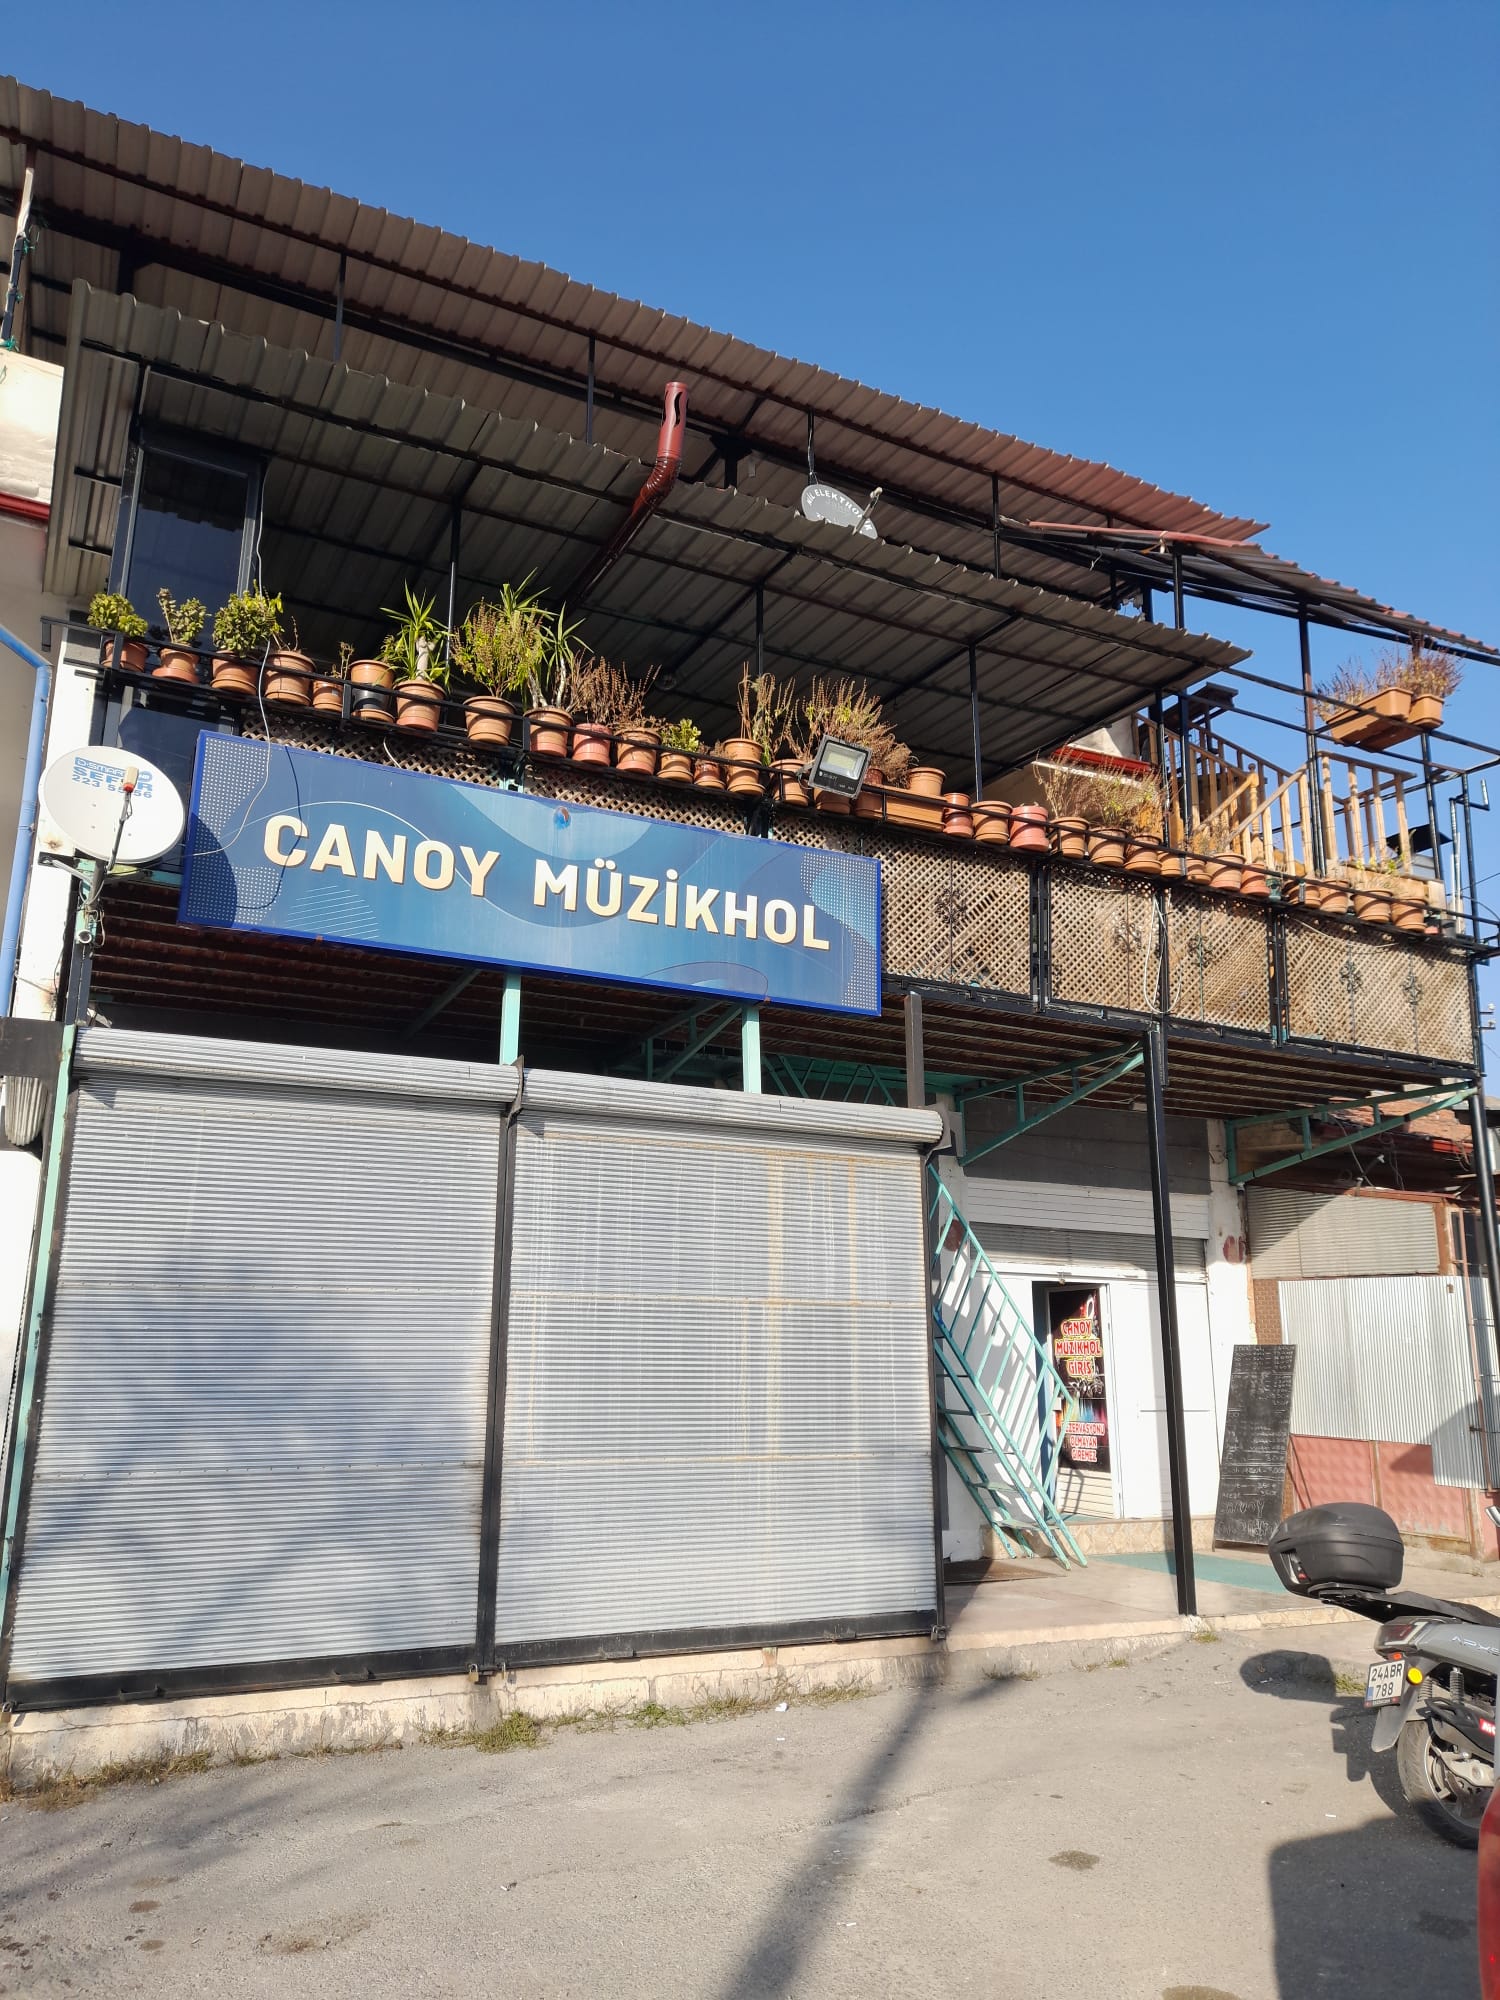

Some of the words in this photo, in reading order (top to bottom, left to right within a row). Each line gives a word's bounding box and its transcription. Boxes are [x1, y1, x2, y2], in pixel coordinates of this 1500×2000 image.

[75, 758, 125, 777] D-SMAR
[72, 774, 101, 788] 223
[73, 766, 153, 791] SEFR
[263, 814, 501, 897] CANOY
[532, 857, 831, 951] MÜZİKHOL
[1062, 1321, 1092, 1336] CANOY
[1375, 1683, 1394, 1697] 788
